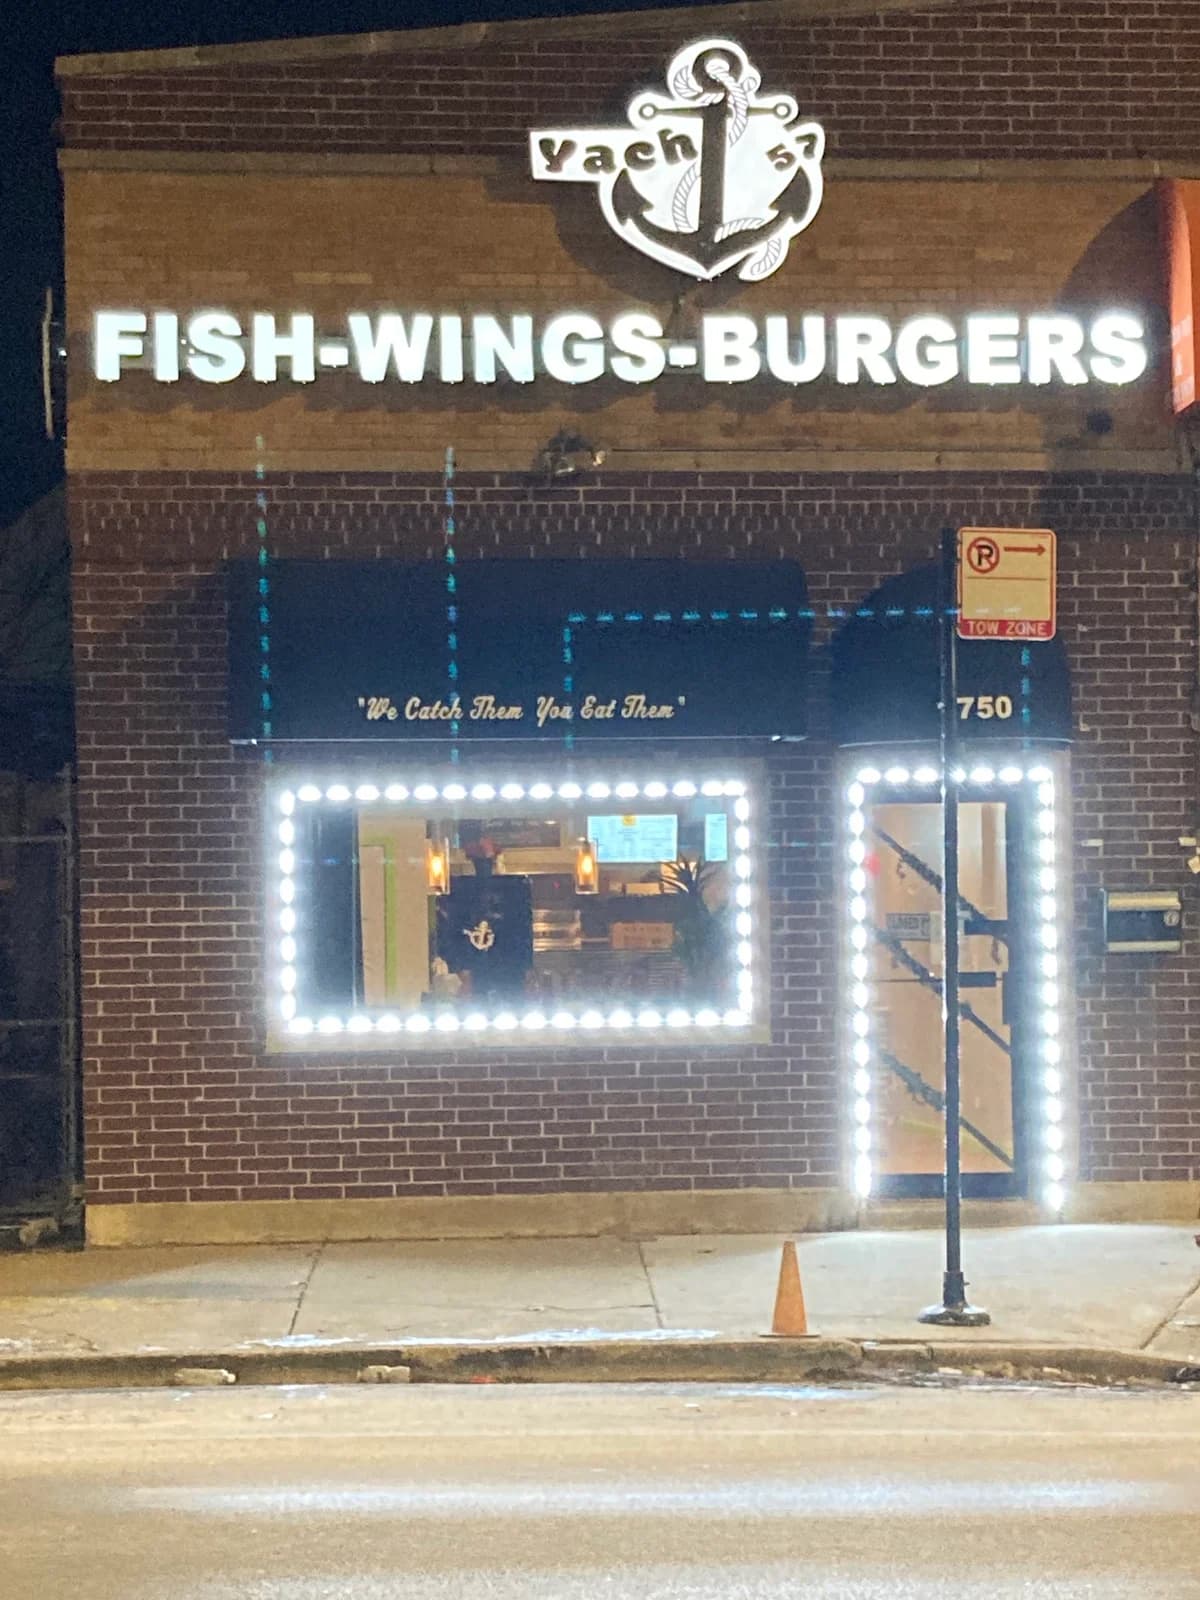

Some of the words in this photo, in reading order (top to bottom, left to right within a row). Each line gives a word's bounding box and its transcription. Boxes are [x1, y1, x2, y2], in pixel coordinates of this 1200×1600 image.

[766, 132, 819, 171] 57
[94, 311, 1149, 386] FISH-WINGS-BURGERS
[967, 620, 999, 635] TOW
[1005, 620, 1048, 637] ZONE
[404, 696, 463, 720] Catch
[469, 695, 523, 720] Them
[535, 696, 573, 728] You
[580, 695, 617, 719] Eat
[956, 695, 1013, 720] 750
